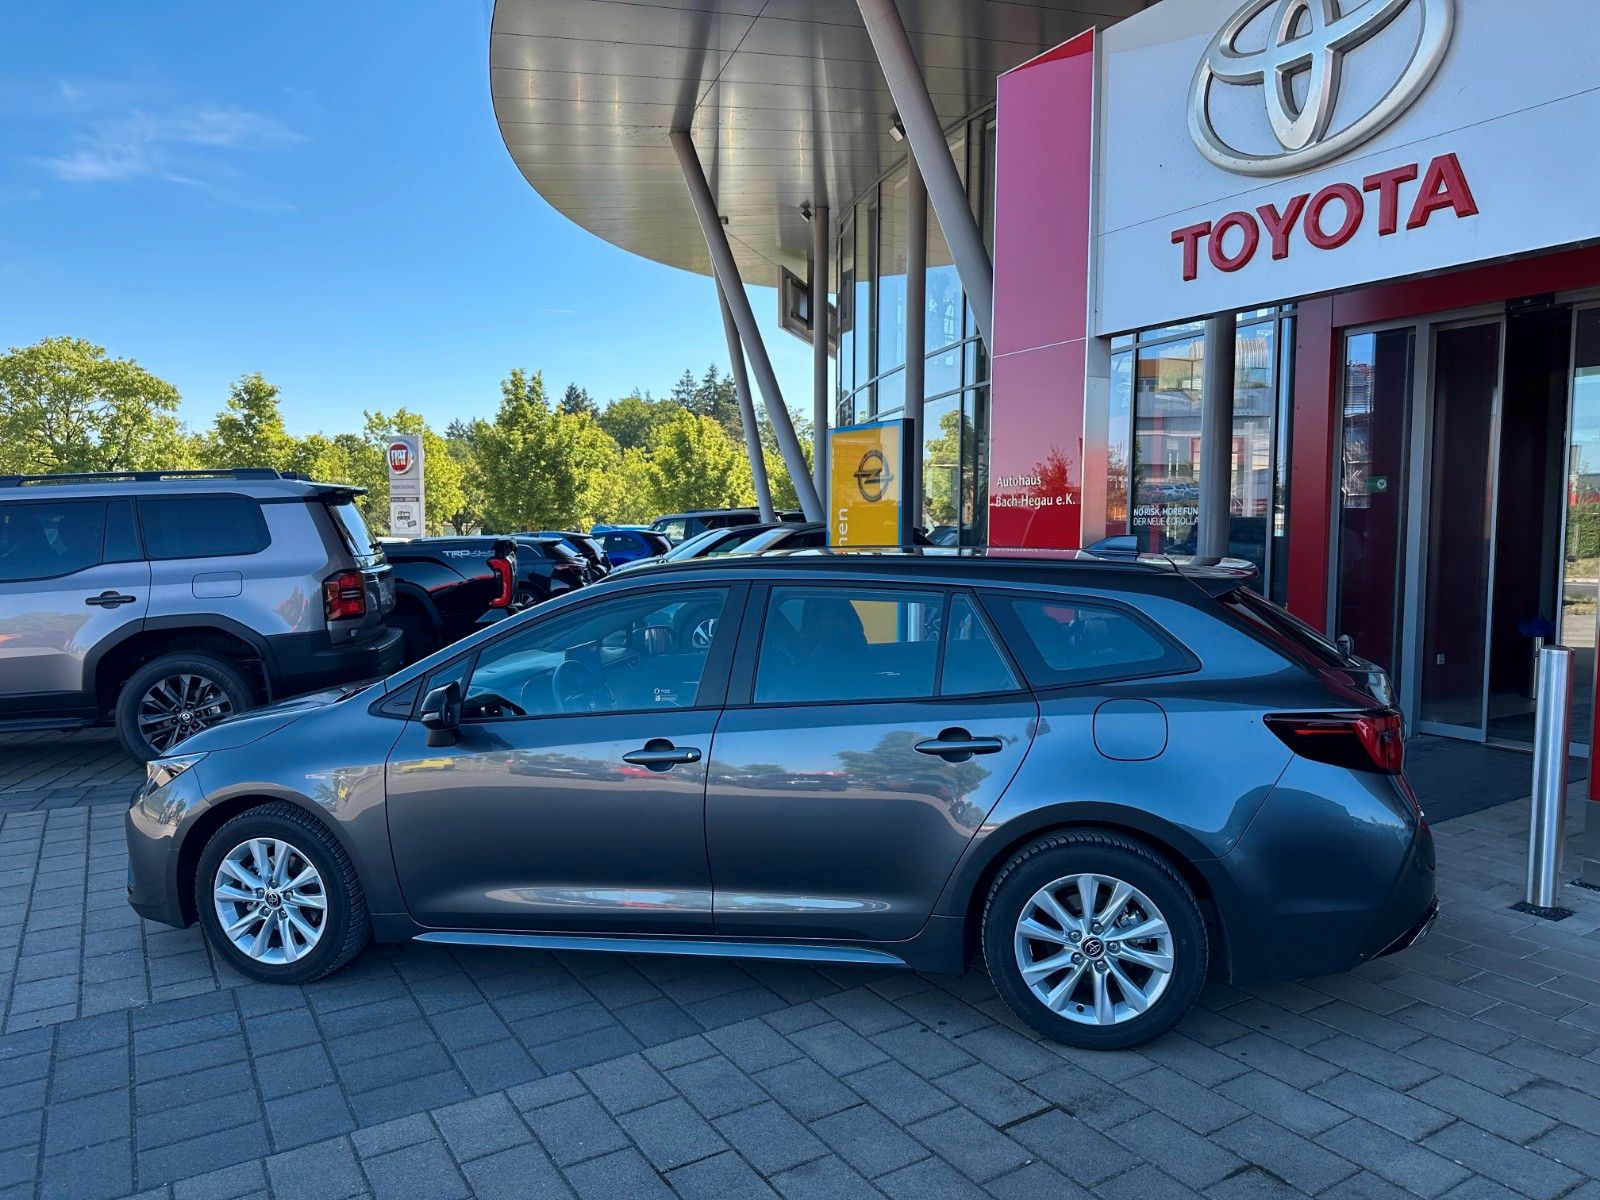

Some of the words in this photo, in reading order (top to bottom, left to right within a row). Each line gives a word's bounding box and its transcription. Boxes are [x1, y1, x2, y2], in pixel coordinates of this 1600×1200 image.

[1171, 153, 1479, 281] TOYOTA
[390, 450, 407, 466] FIAT
[997, 475, 1042, 487] Autohaus
[996, 495, 1053, 510] Bach-Hegau
[1056, 493, 1076, 505] e.K.
[1133, 508, 1144, 516] NO
[1162, 507, 1183, 516] MORE
[1183, 507, 1199, 515] FUN
[1133, 517, 1147, 525] DER
[1147, 517, 1166, 525] NEUE
[1166, 516, 1199, 525] COROLLA
